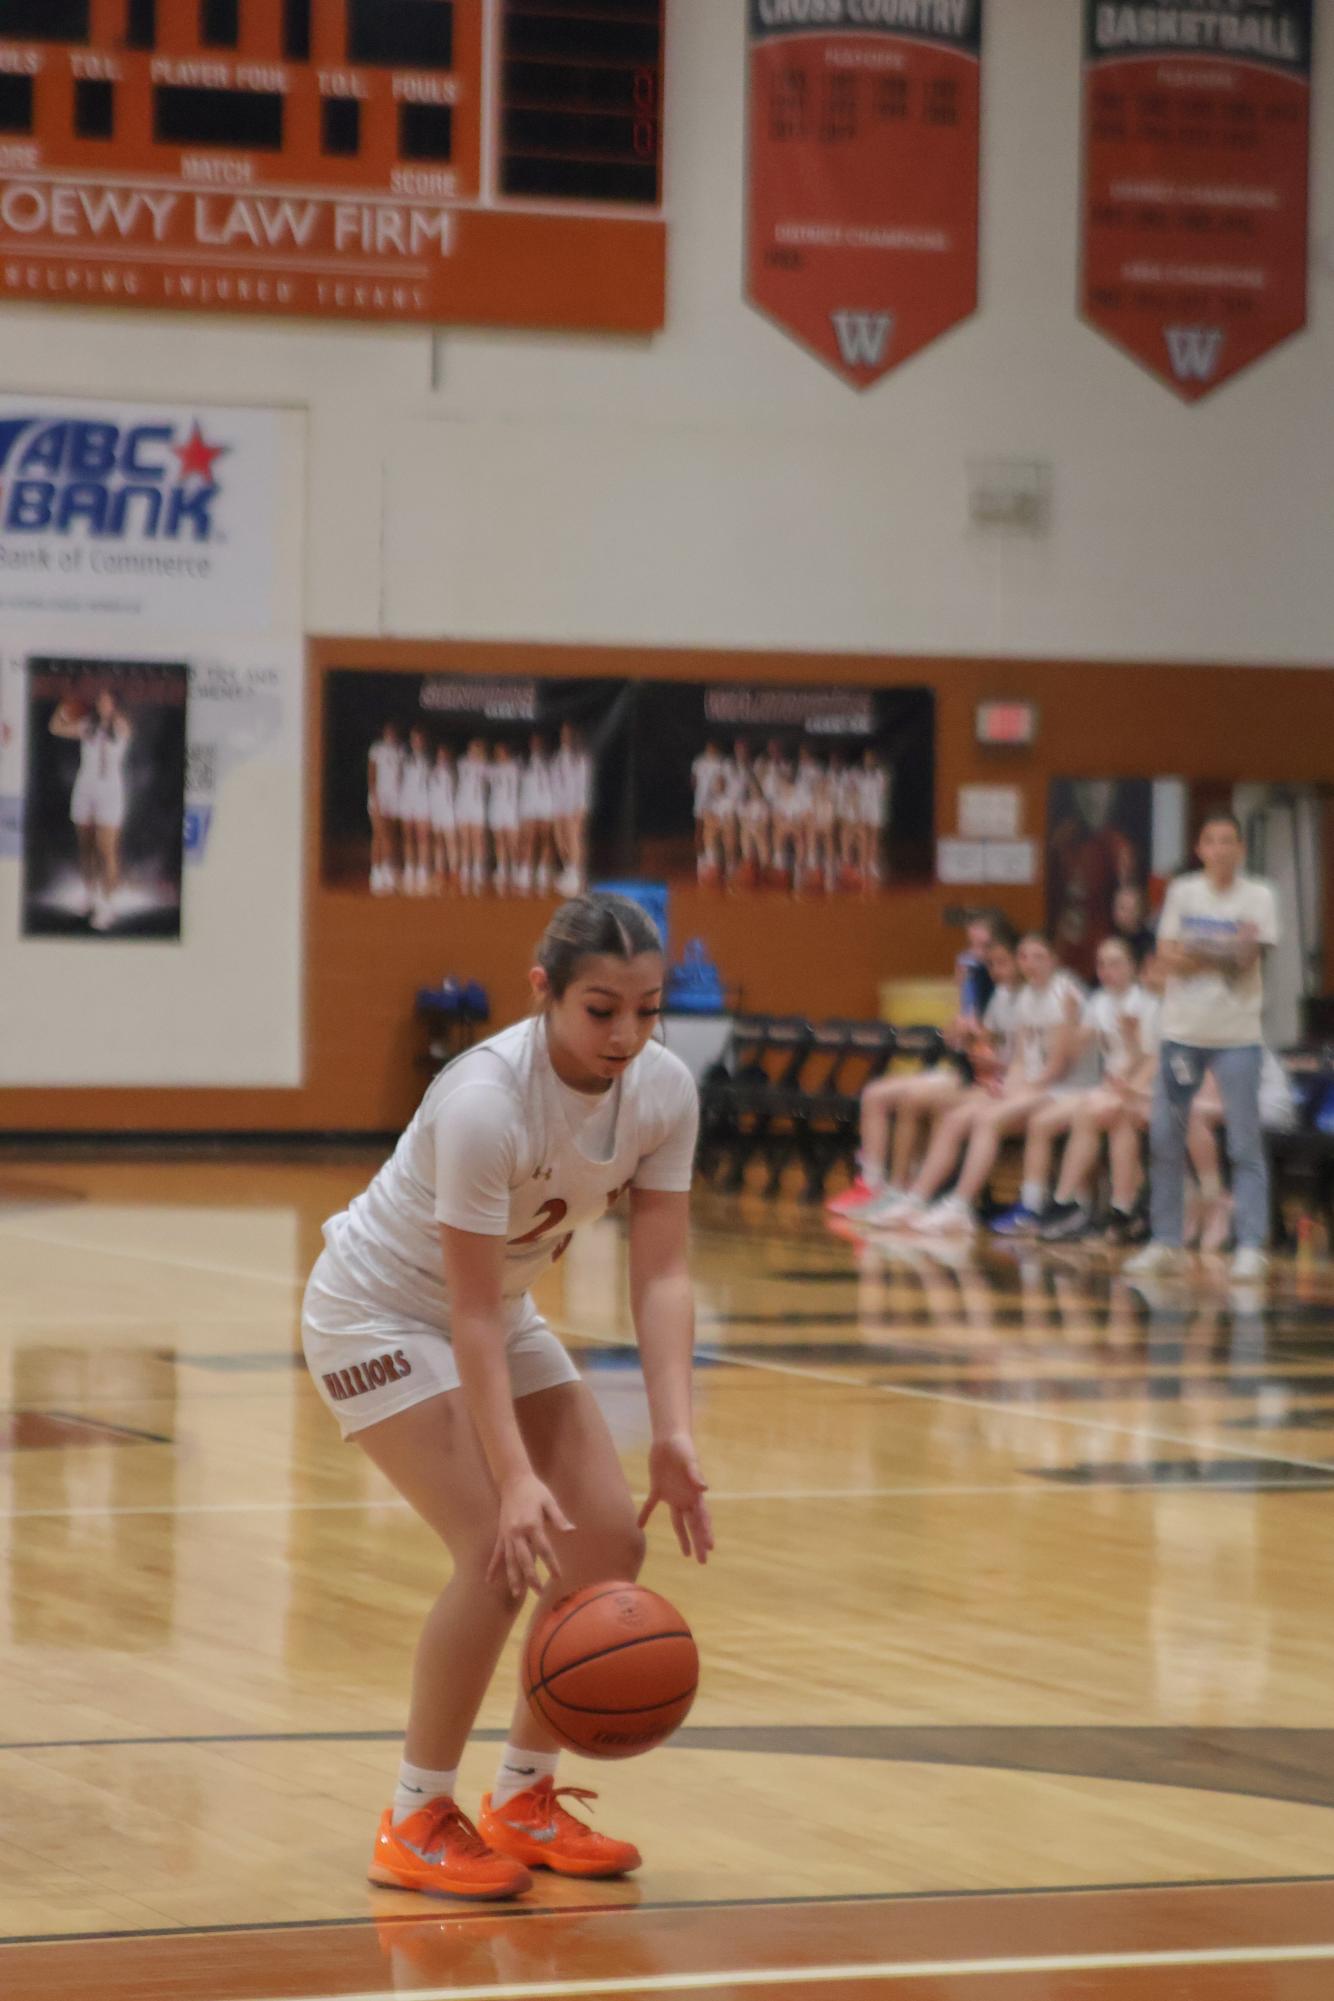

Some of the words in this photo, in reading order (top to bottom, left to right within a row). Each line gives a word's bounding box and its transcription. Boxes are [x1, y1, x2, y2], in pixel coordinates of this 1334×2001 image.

[757, 0, 843, 25] CROSS
[847, 0, 967, 36] COUNTRY
[1095, 5, 1297, 58] BASKETBALL
[151, 57, 228, 88] PLAYER
[391, 74, 458, 104] FOULS
[181, 155, 252, 184] MATCH
[391, 168, 457, 197] SCORE
[193, 193, 318, 247] LAW
[333, 204, 453, 257] FIRM
[831, 310, 893, 365] W
[1161, 323, 1223, 379] W
[17, 419, 174, 480] ABC
[5, 480, 219, 542] BANK
[57, 548, 81, 573] of
[89, 552, 211, 578] Commerce
